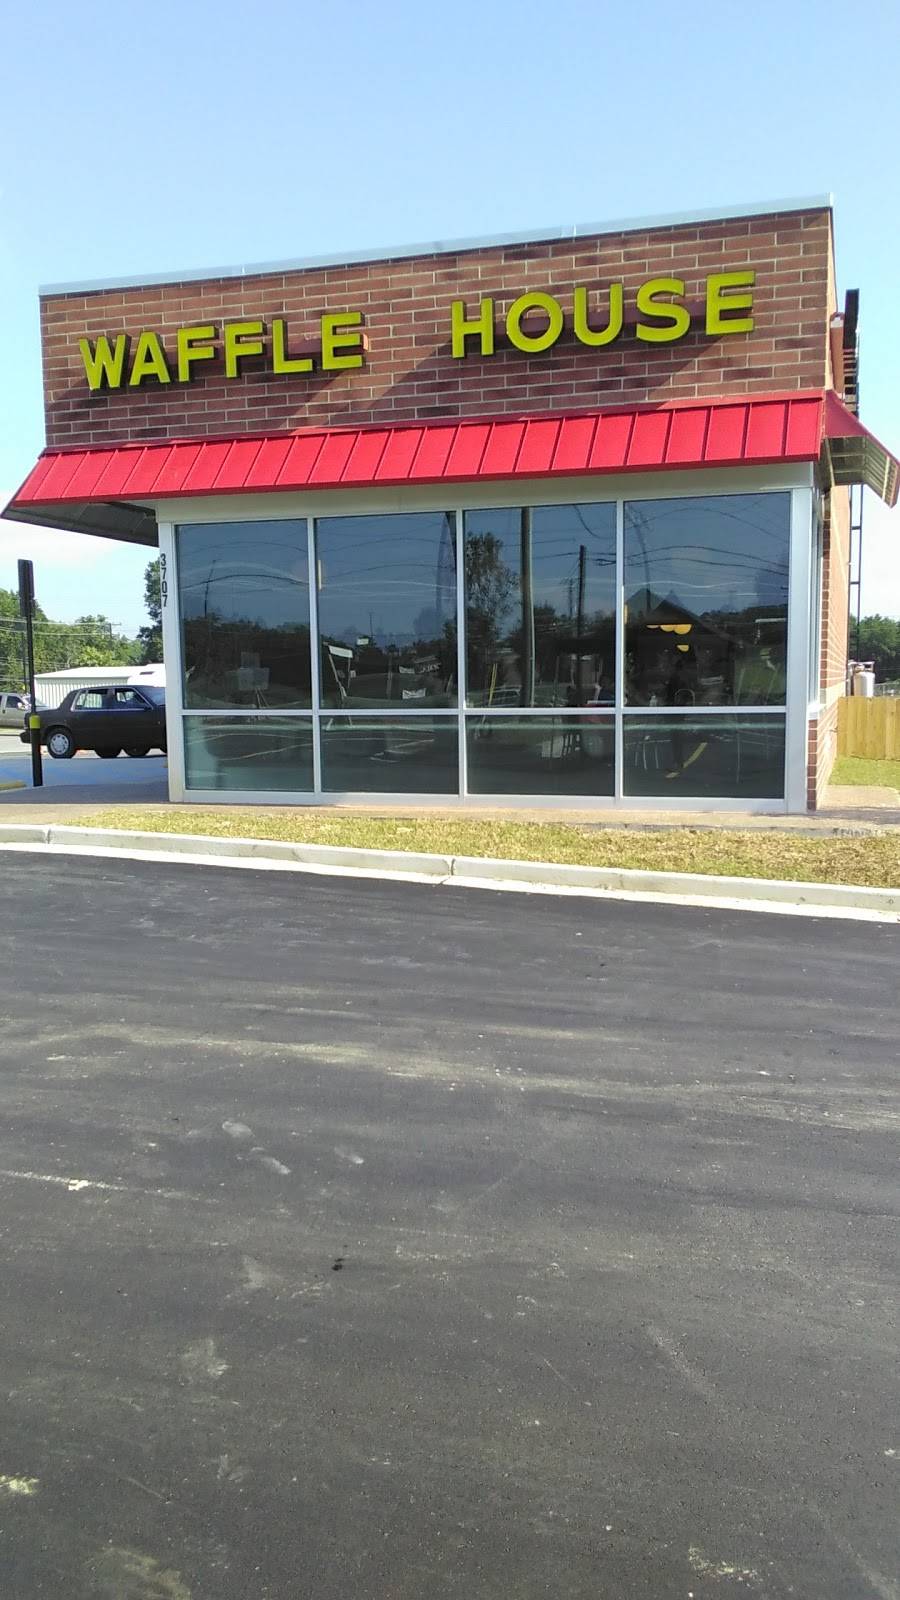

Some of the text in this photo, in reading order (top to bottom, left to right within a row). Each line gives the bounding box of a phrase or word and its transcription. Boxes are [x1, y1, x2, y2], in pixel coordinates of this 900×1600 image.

[78, 270, 757, 391] WAFFLE HOUSE
[160, 553, 168, 607] 3707
